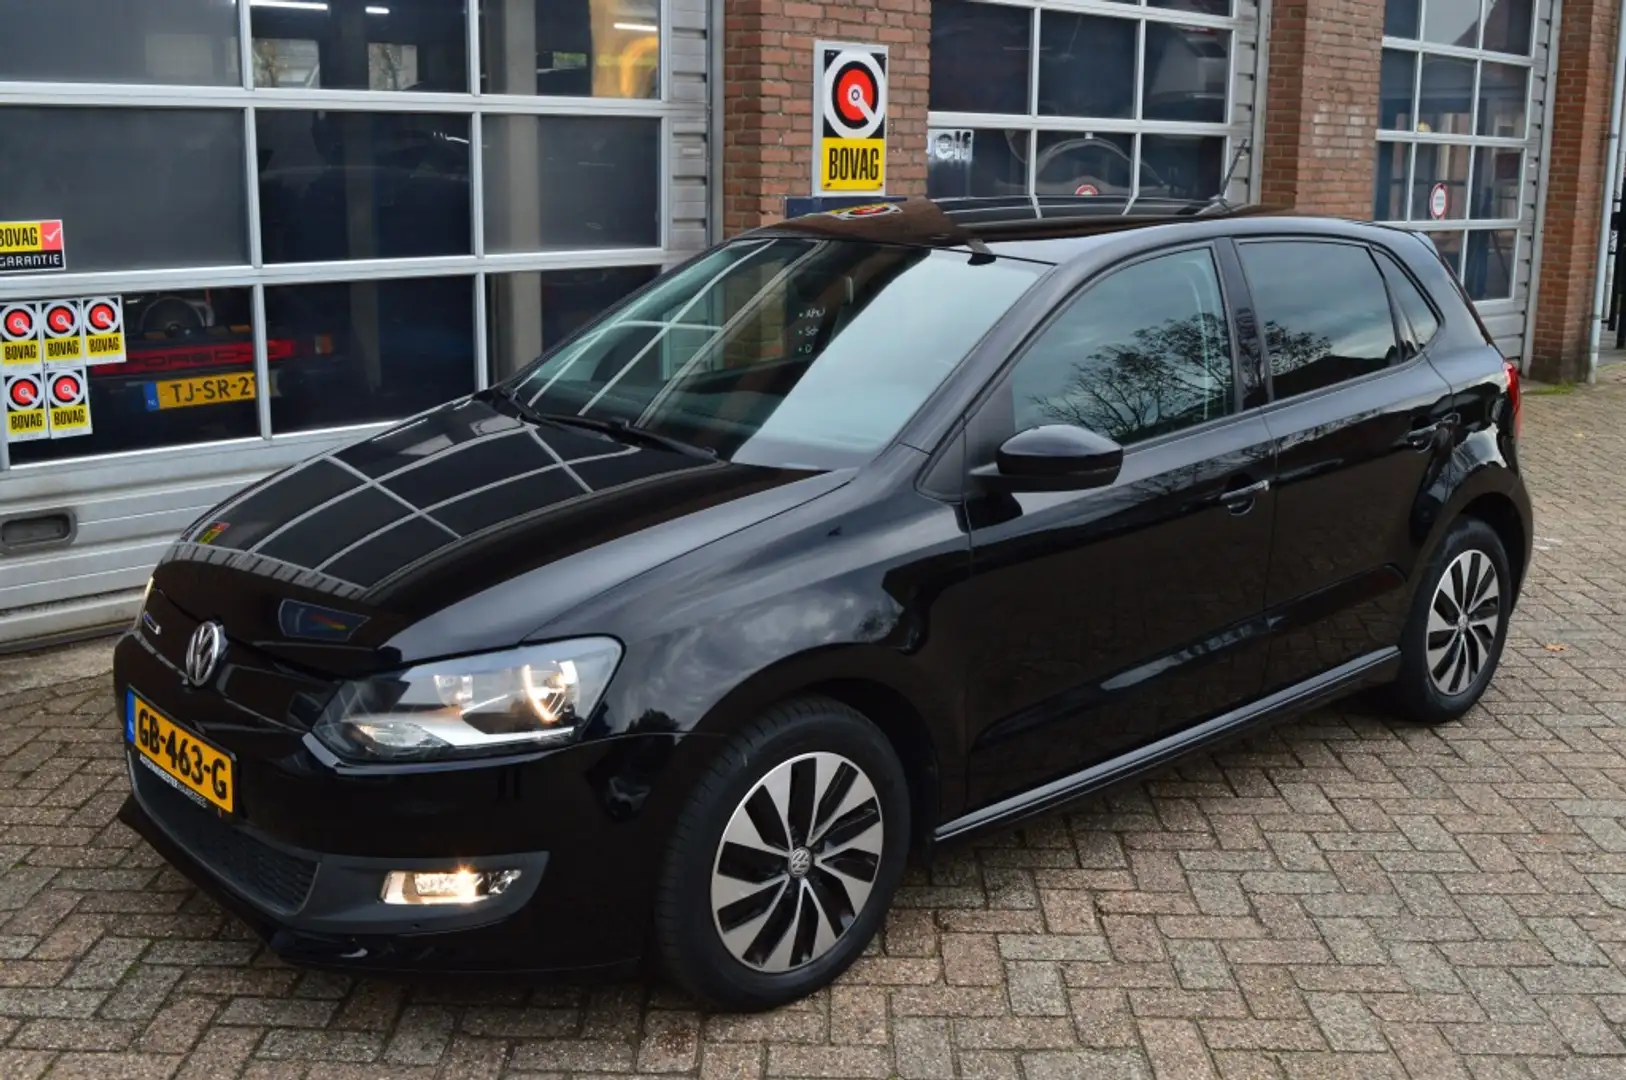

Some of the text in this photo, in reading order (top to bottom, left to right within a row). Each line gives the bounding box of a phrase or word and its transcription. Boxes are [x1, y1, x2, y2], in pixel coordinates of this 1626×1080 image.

[828, 147, 880, 181] BOVAG
[4, 344, 36, 360] BOVAG
[47, 340, 79, 357] BOVAG
[88, 336, 120, 353] BOVAG
[170, 375, 256, 404] TJ-SR-2
[11, 412, 42, 430] BOVAG
[54, 409, 85, 426] BOVAG
[138, 708, 227, 800] GB-463-G
